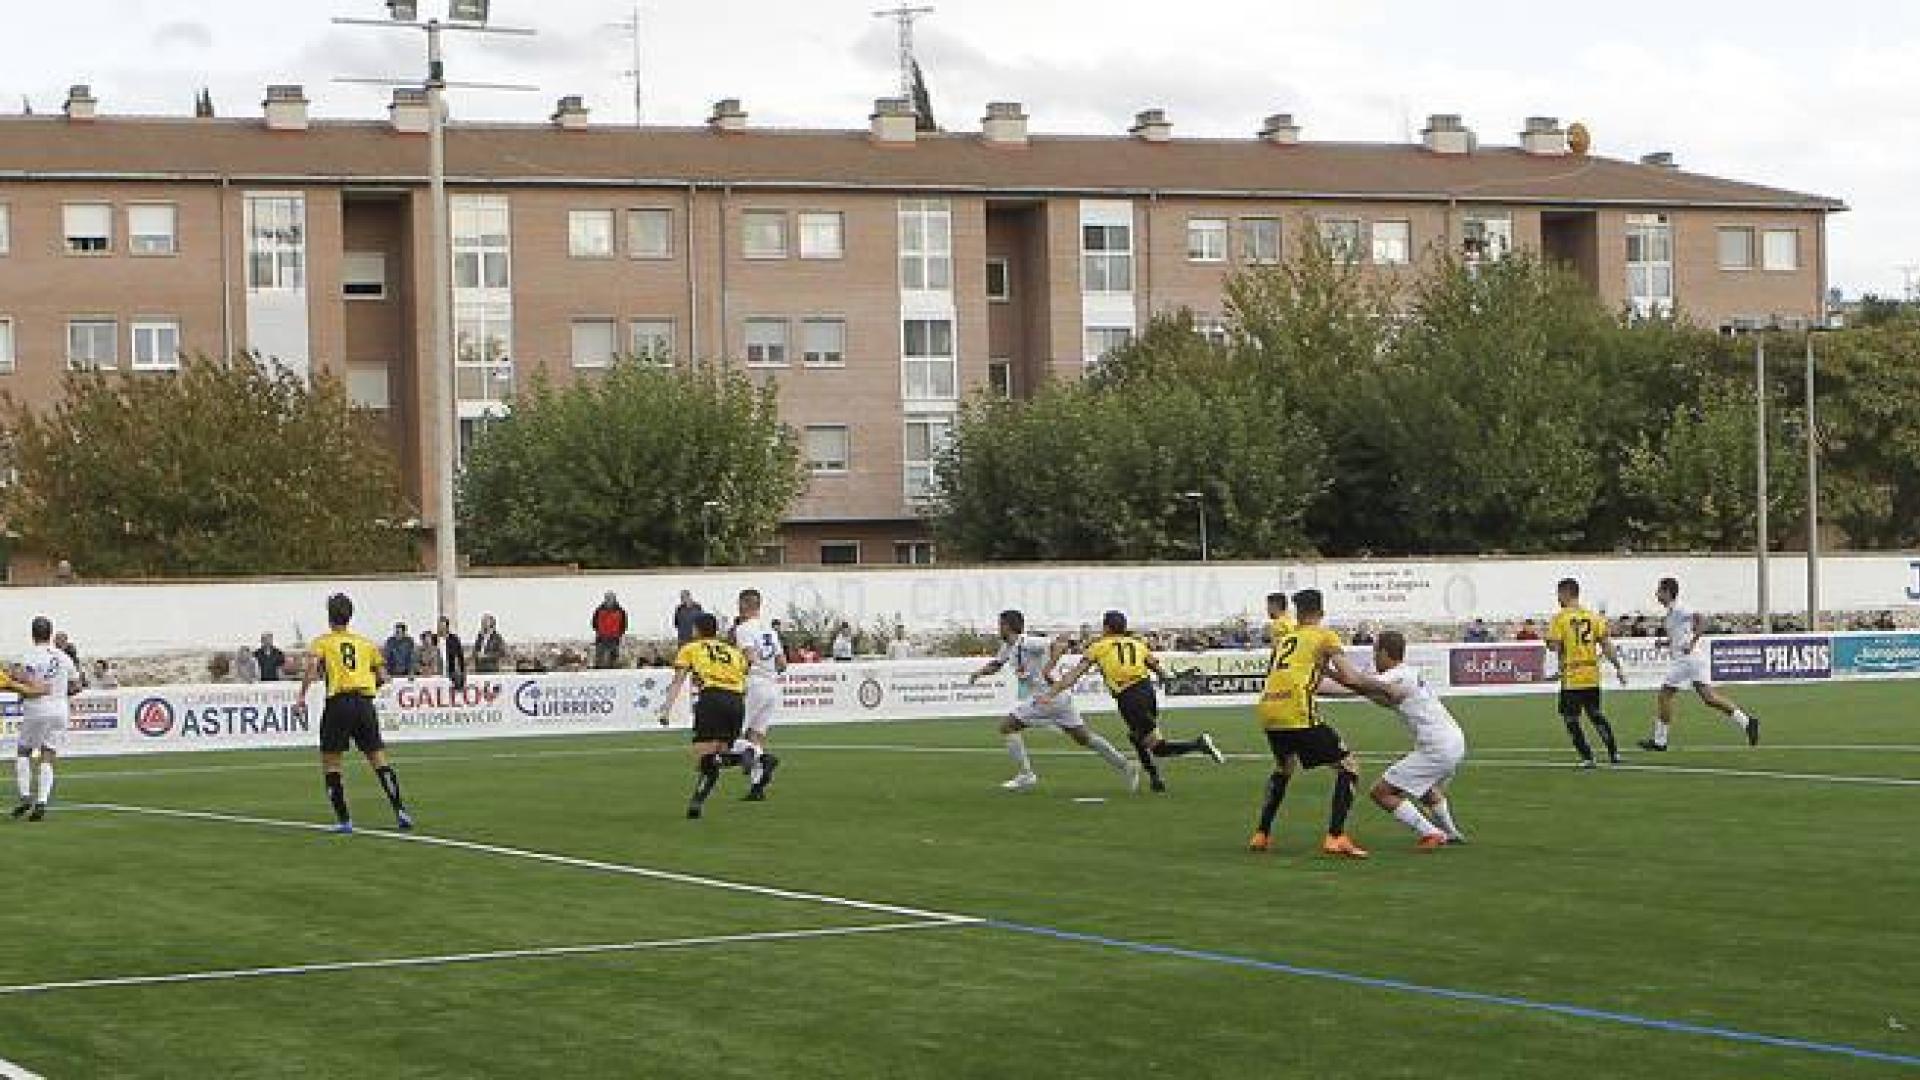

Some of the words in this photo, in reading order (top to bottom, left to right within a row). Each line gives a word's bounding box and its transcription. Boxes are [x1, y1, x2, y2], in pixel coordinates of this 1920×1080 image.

[1570, 618, 1591, 643] 12
[340, 641, 356, 671] 8
[703, 639, 732, 664] 15
[1112, 641, 1138, 667] 11
[1765, 645, 1829, 672] PHASIS
[399, 684, 482, 708] GALLO
[181, 706, 309, 737] ASTRAIN
